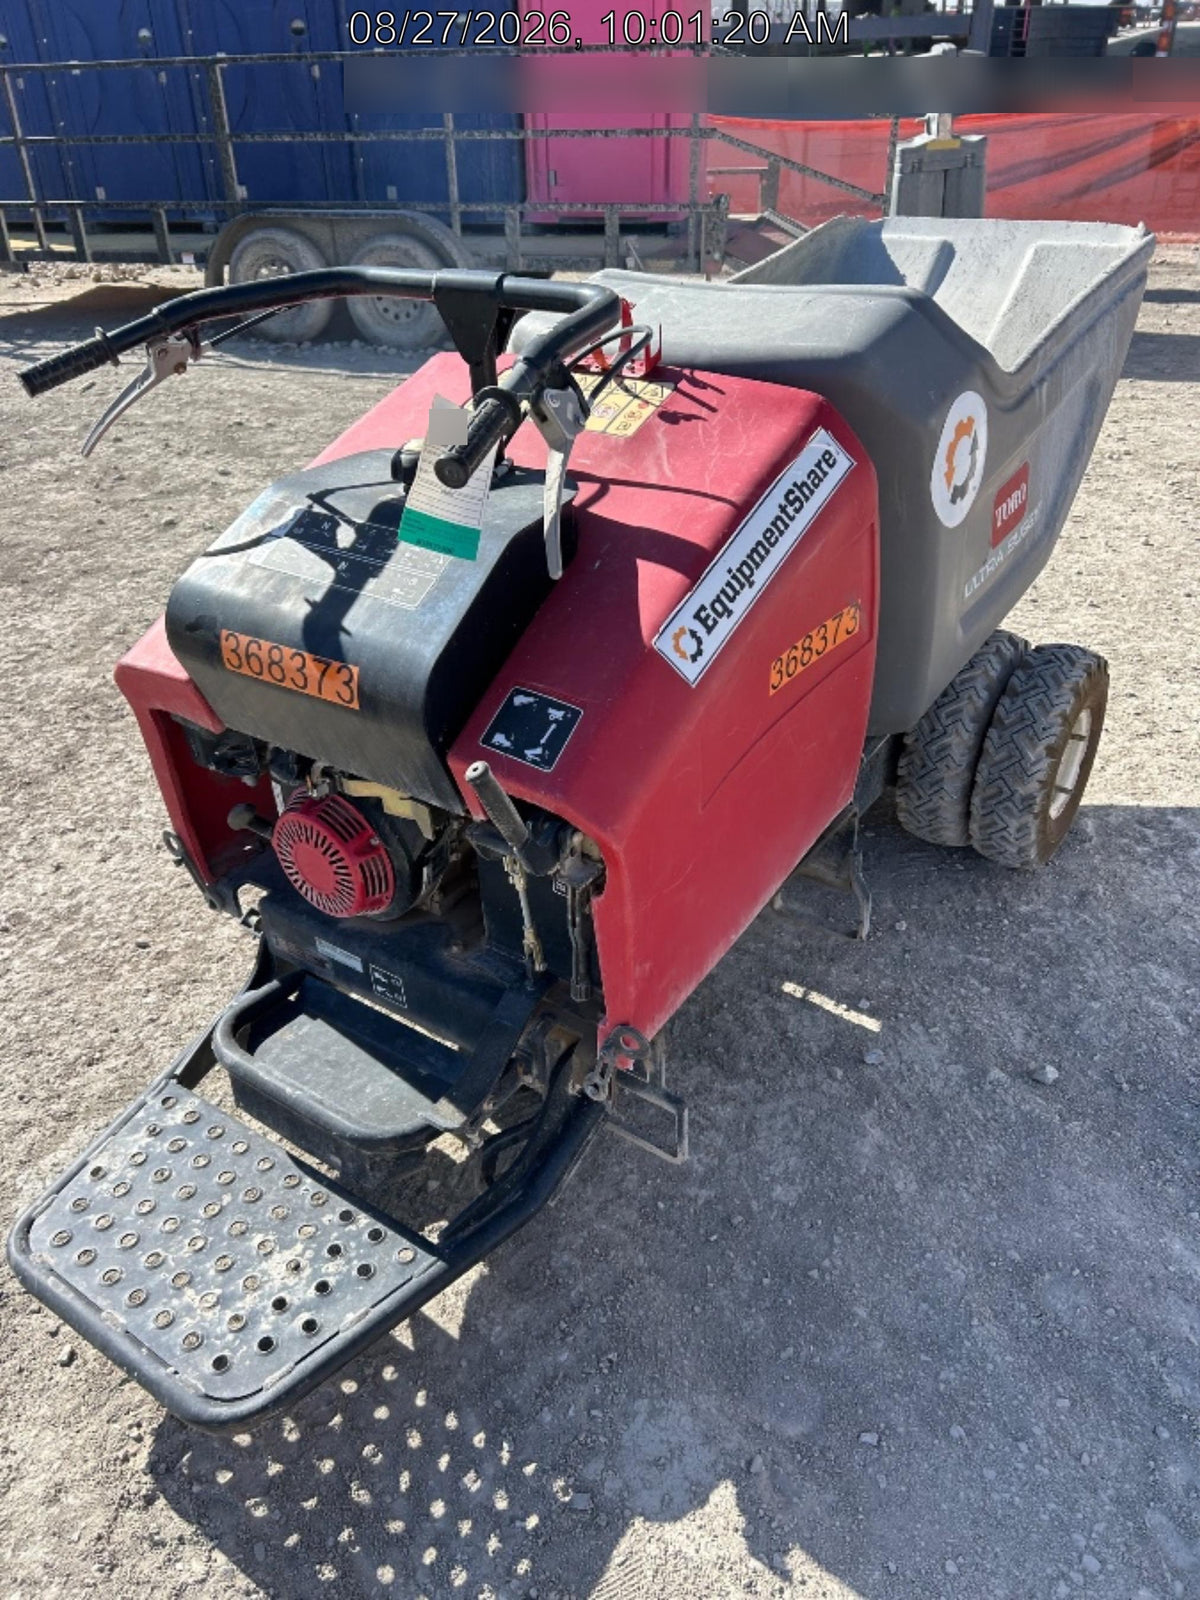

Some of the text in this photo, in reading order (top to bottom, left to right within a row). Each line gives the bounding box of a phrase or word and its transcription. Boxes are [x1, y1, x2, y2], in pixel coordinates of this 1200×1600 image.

[693, 449, 837, 635] EquipmentShare
[995, 482, 1027, 528] TORO
[224, 632, 355, 705] 368373
[771, 602, 860, 690] 368373
